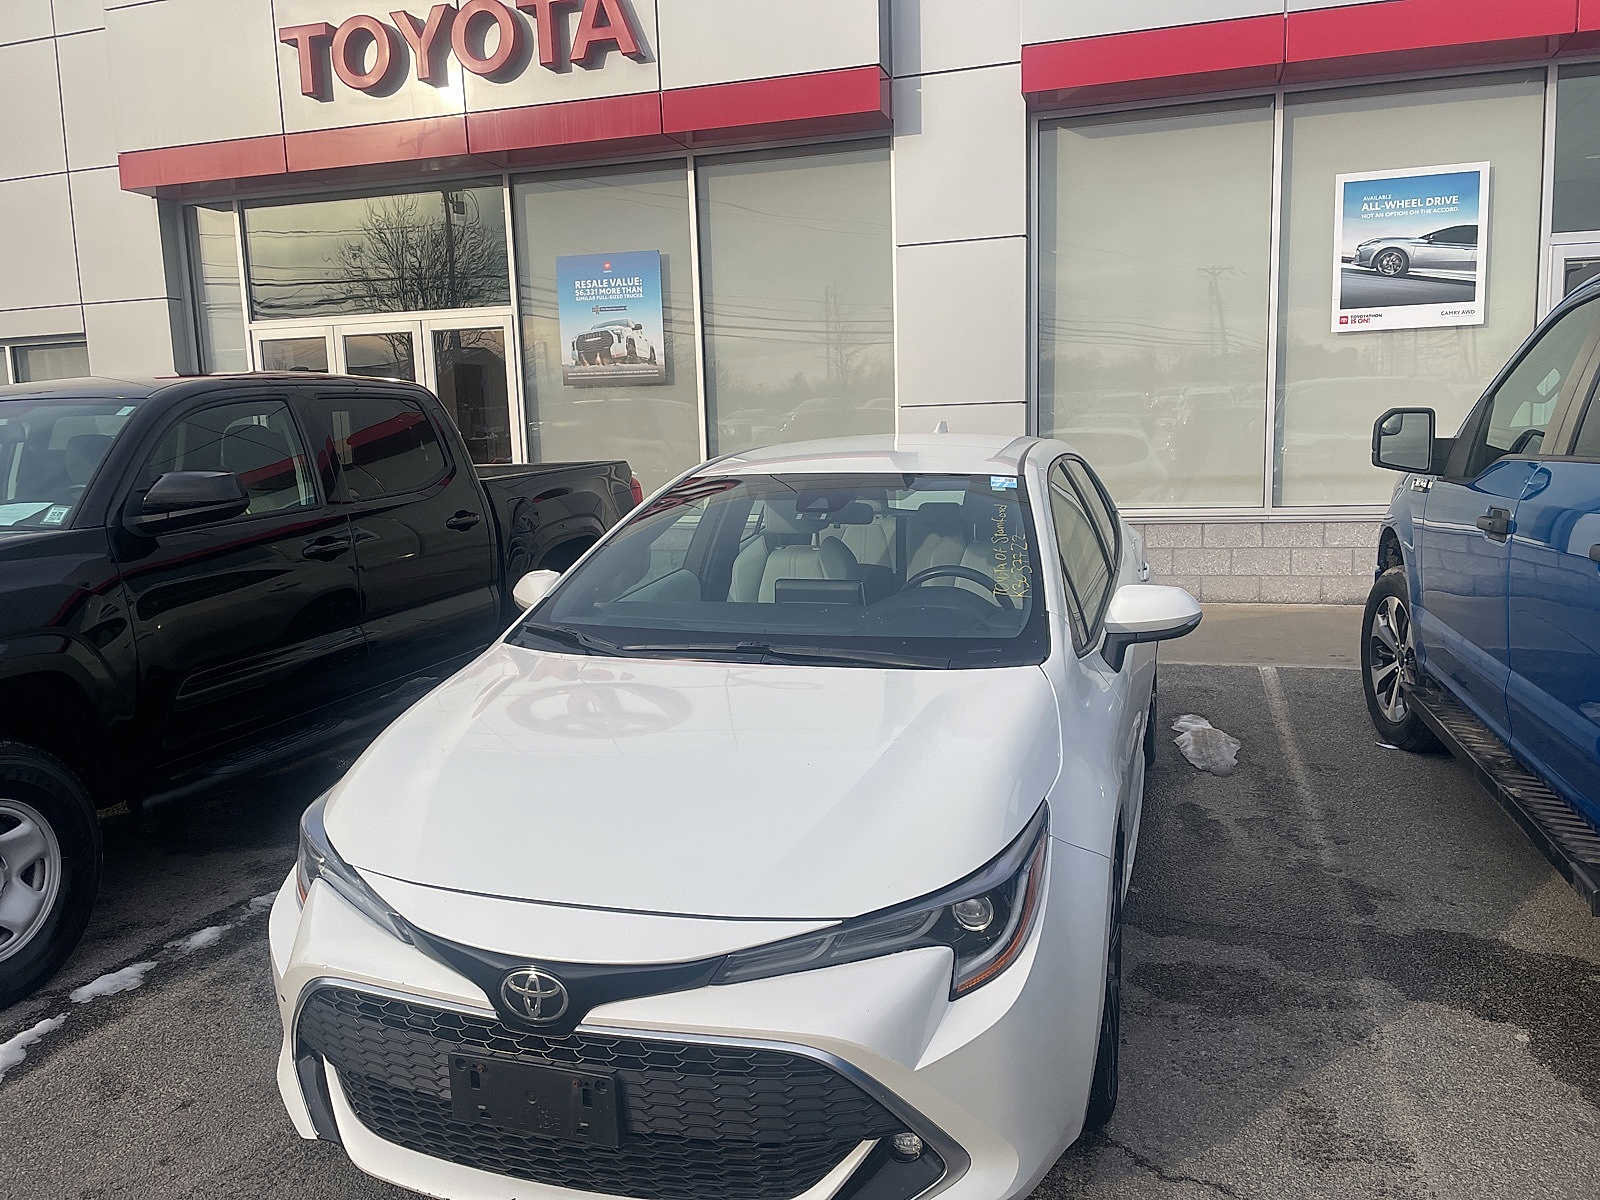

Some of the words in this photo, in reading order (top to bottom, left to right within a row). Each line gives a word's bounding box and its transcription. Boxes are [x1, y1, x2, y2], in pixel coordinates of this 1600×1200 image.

[279, 0, 648, 100] TOYOTA
[1361, 198, 1423, 212] ALL-WHEEL
[1425, 196, 1459, 206] DRIVE
[575, 279, 608, 289] RESALE
[610, 276, 643, 286] VALUE:
